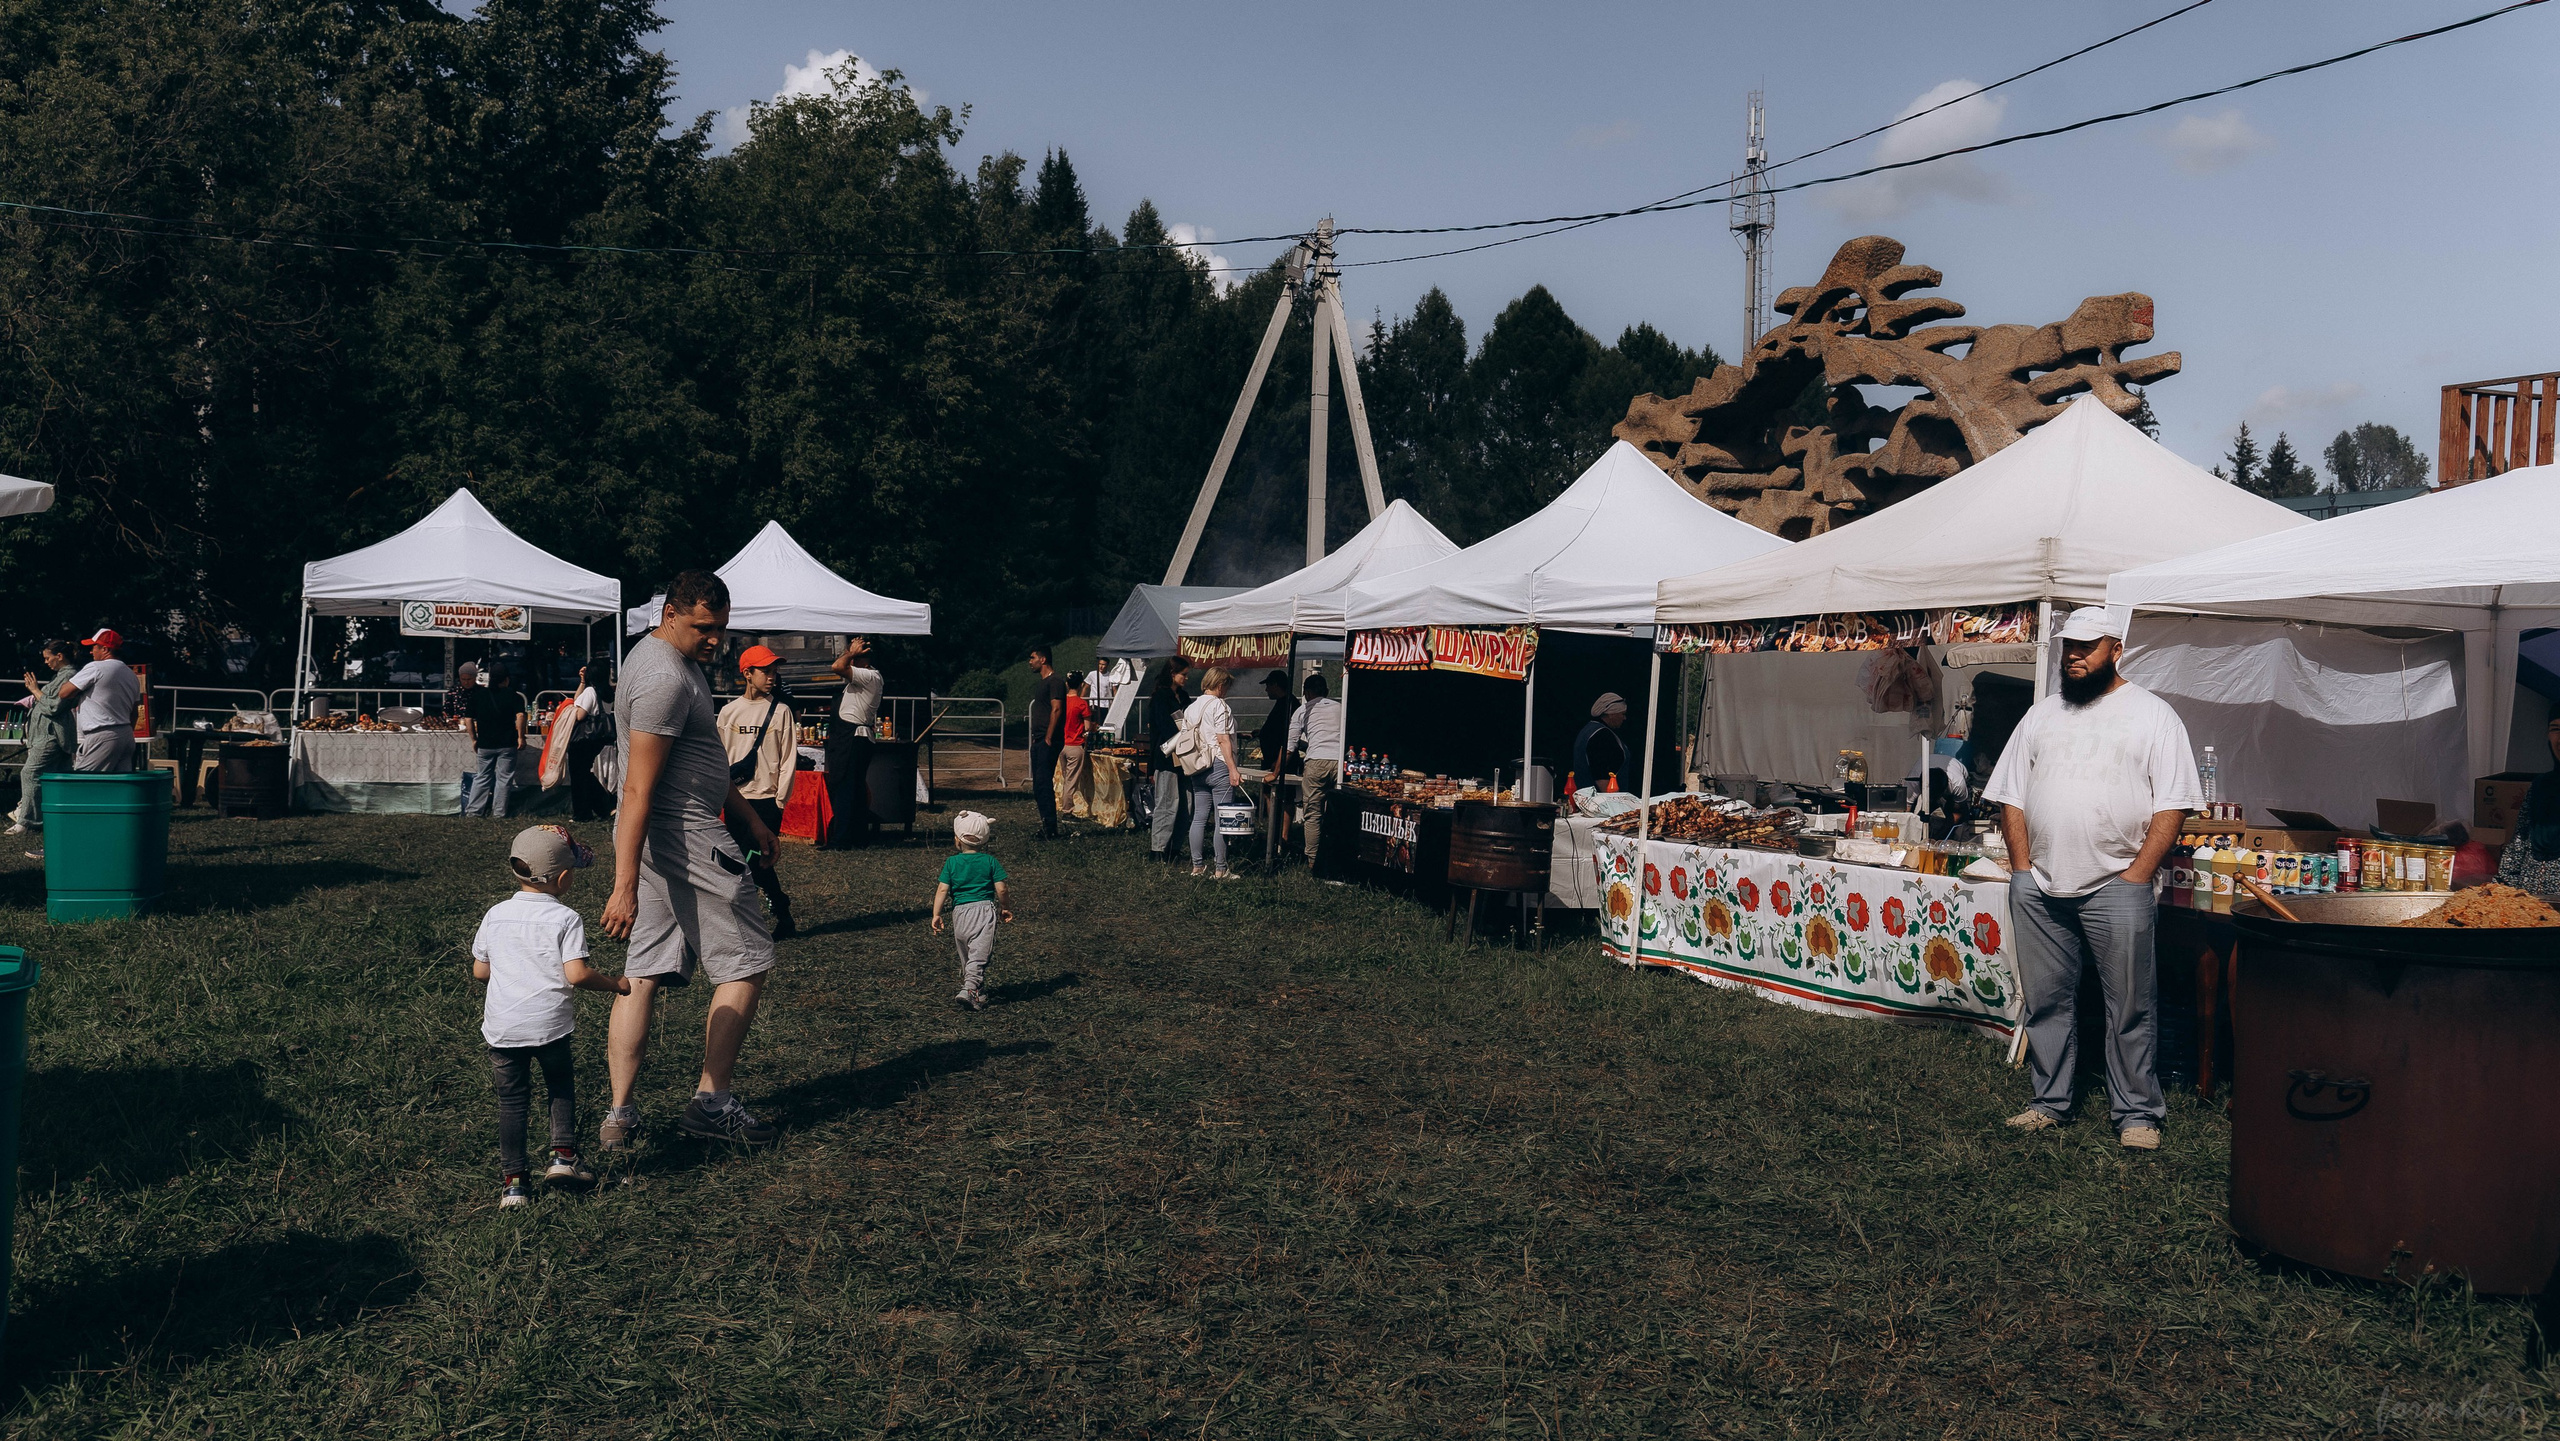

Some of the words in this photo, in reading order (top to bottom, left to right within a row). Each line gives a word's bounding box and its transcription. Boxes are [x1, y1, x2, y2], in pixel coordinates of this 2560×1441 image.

[435, 605, 496, 617] ШАШЛЫК
[435, 616, 496, 629] ШАУРМА
[1655, 624, 1771, 647] ШАШЛЫК
[1788, 613, 1869, 645] ПЛОВ
[1262, 631, 1292, 657] ПЛОВ
[1361, 811, 1417, 843] ШАШЛЫК
